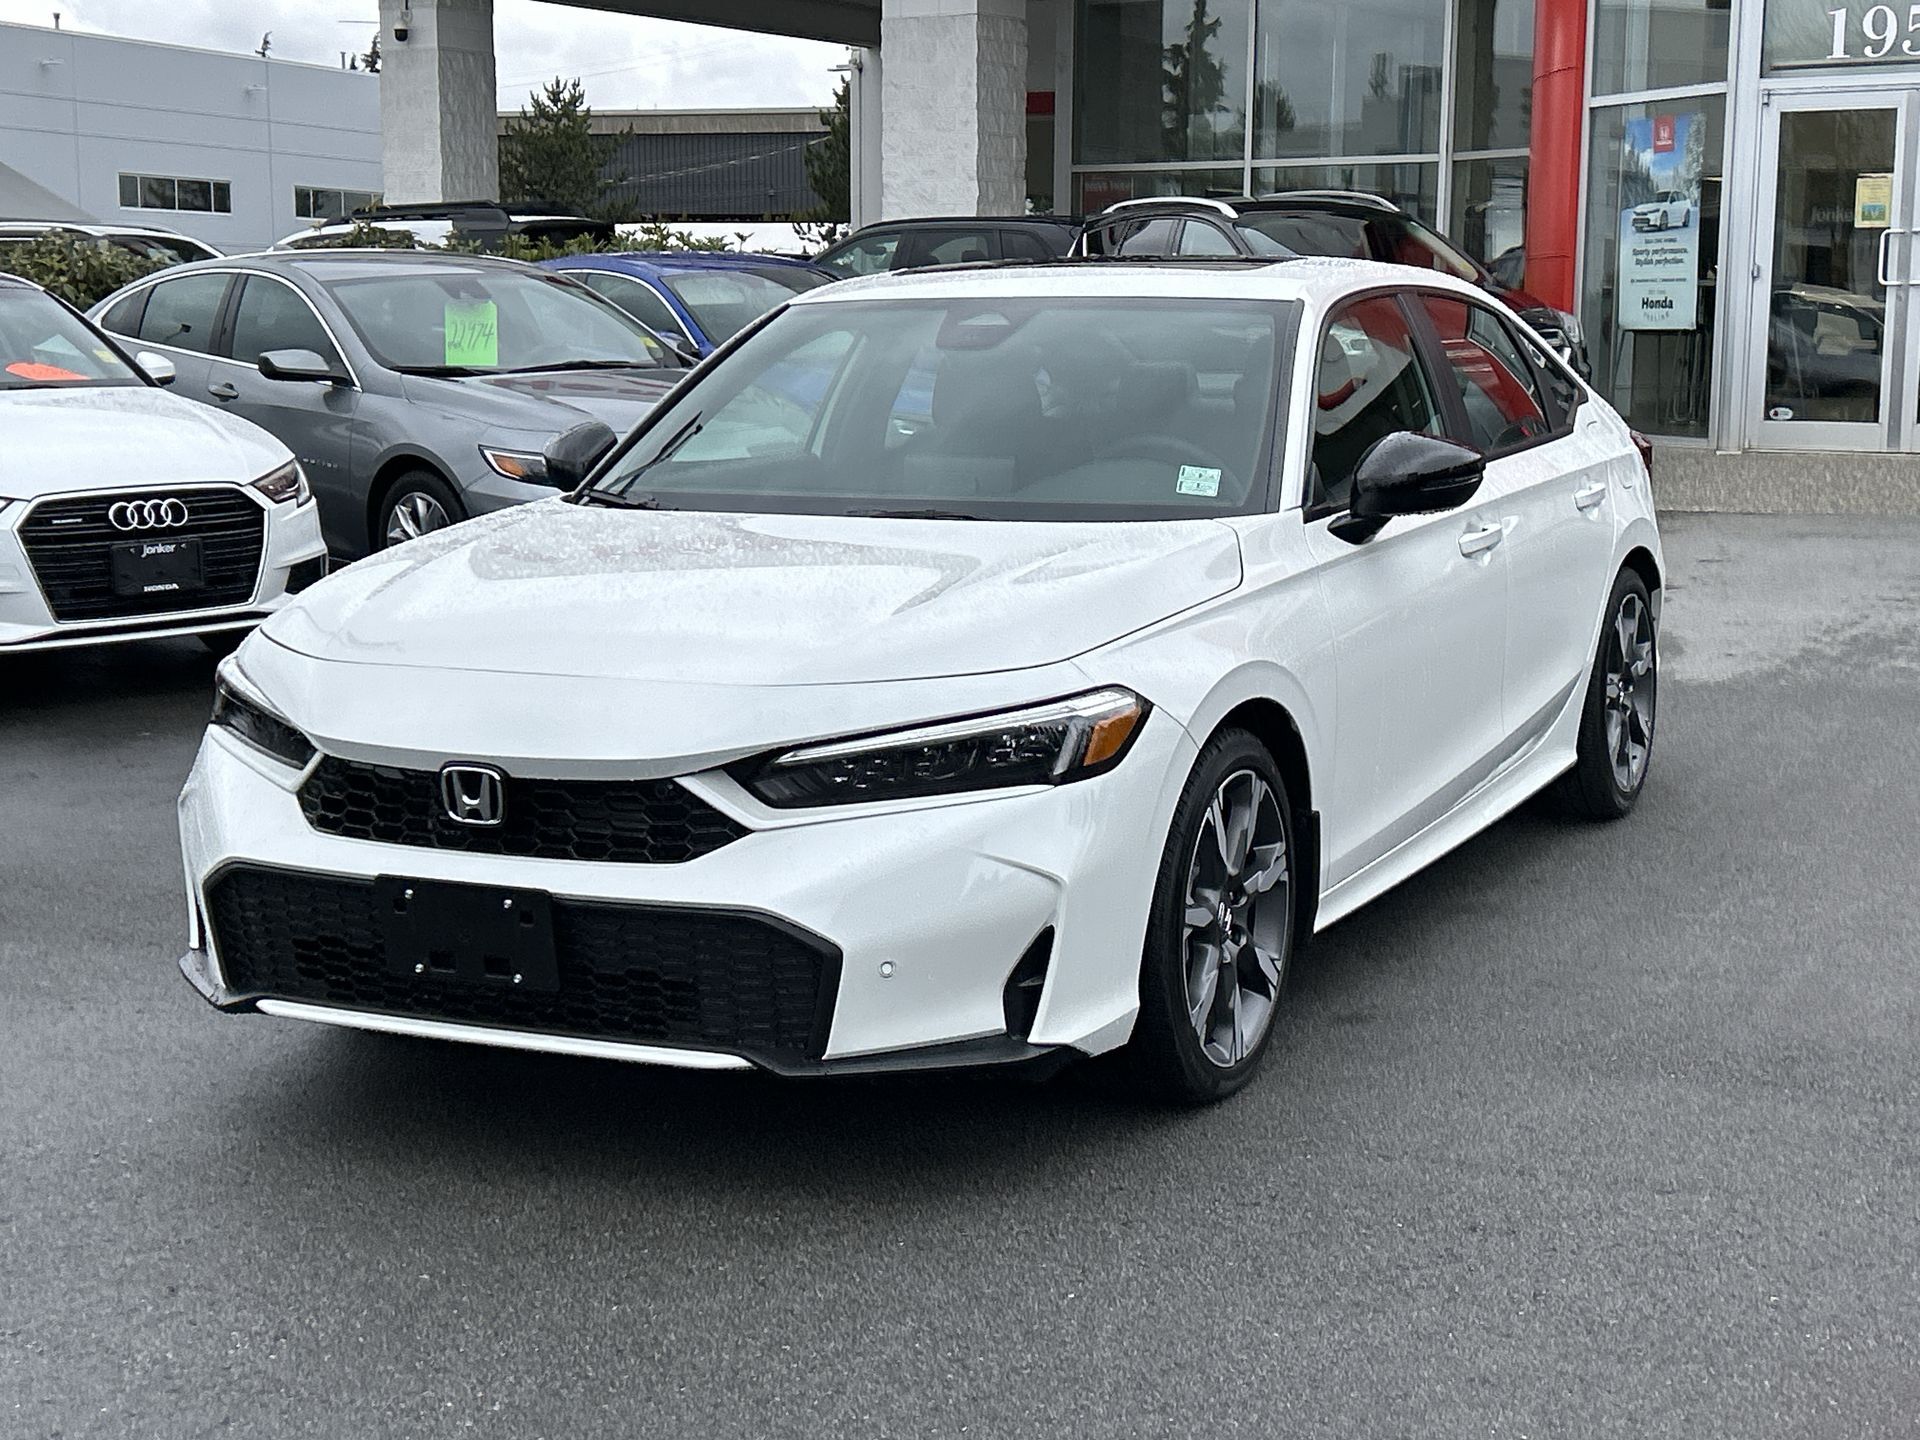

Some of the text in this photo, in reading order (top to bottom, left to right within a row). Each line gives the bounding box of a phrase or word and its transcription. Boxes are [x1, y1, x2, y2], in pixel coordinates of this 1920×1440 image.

[1811, 205, 1854, 223] Jonke
[1641, 296, 1674, 310] Honda
[141, 543, 176, 559] Jonker
[143, 582, 179, 593] HONDA
